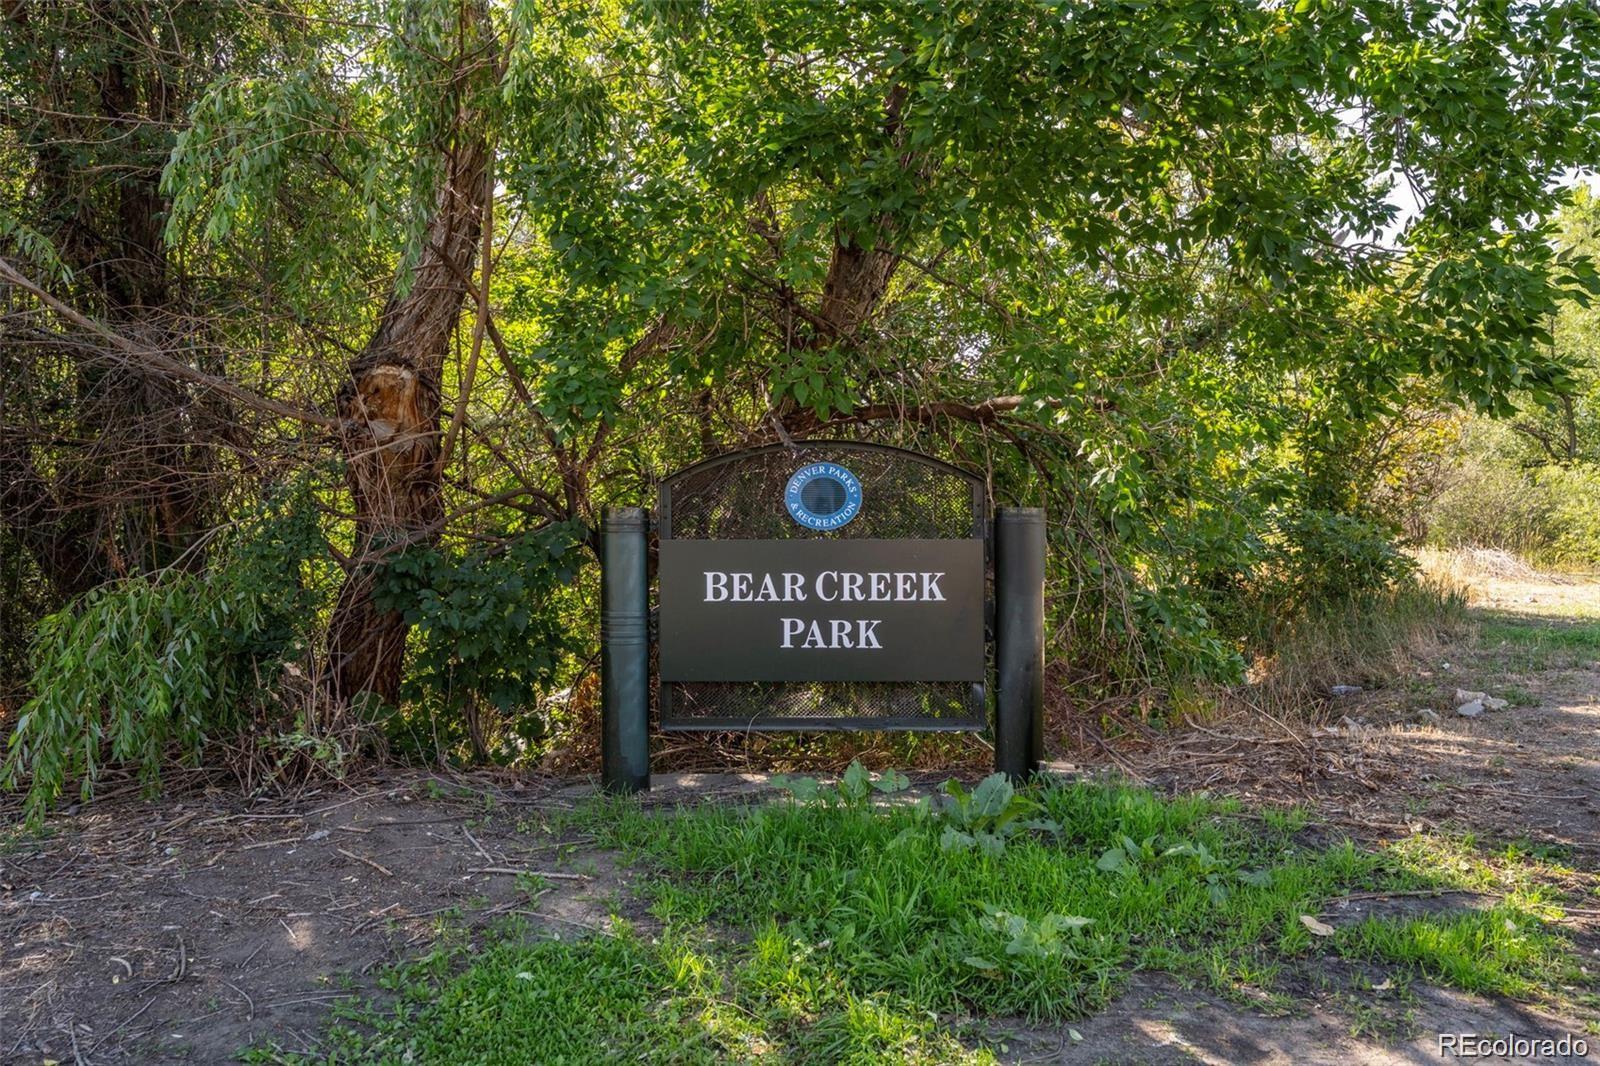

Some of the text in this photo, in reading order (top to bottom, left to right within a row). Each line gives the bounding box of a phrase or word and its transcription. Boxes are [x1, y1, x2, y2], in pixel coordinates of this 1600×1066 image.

[790, 465, 857, 494] DENVER PARKS
[790, 501, 856, 527] & RECREATION
[703, 571, 947, 602] BEAR CREEK
[780, 618, 883, 649] PARK
